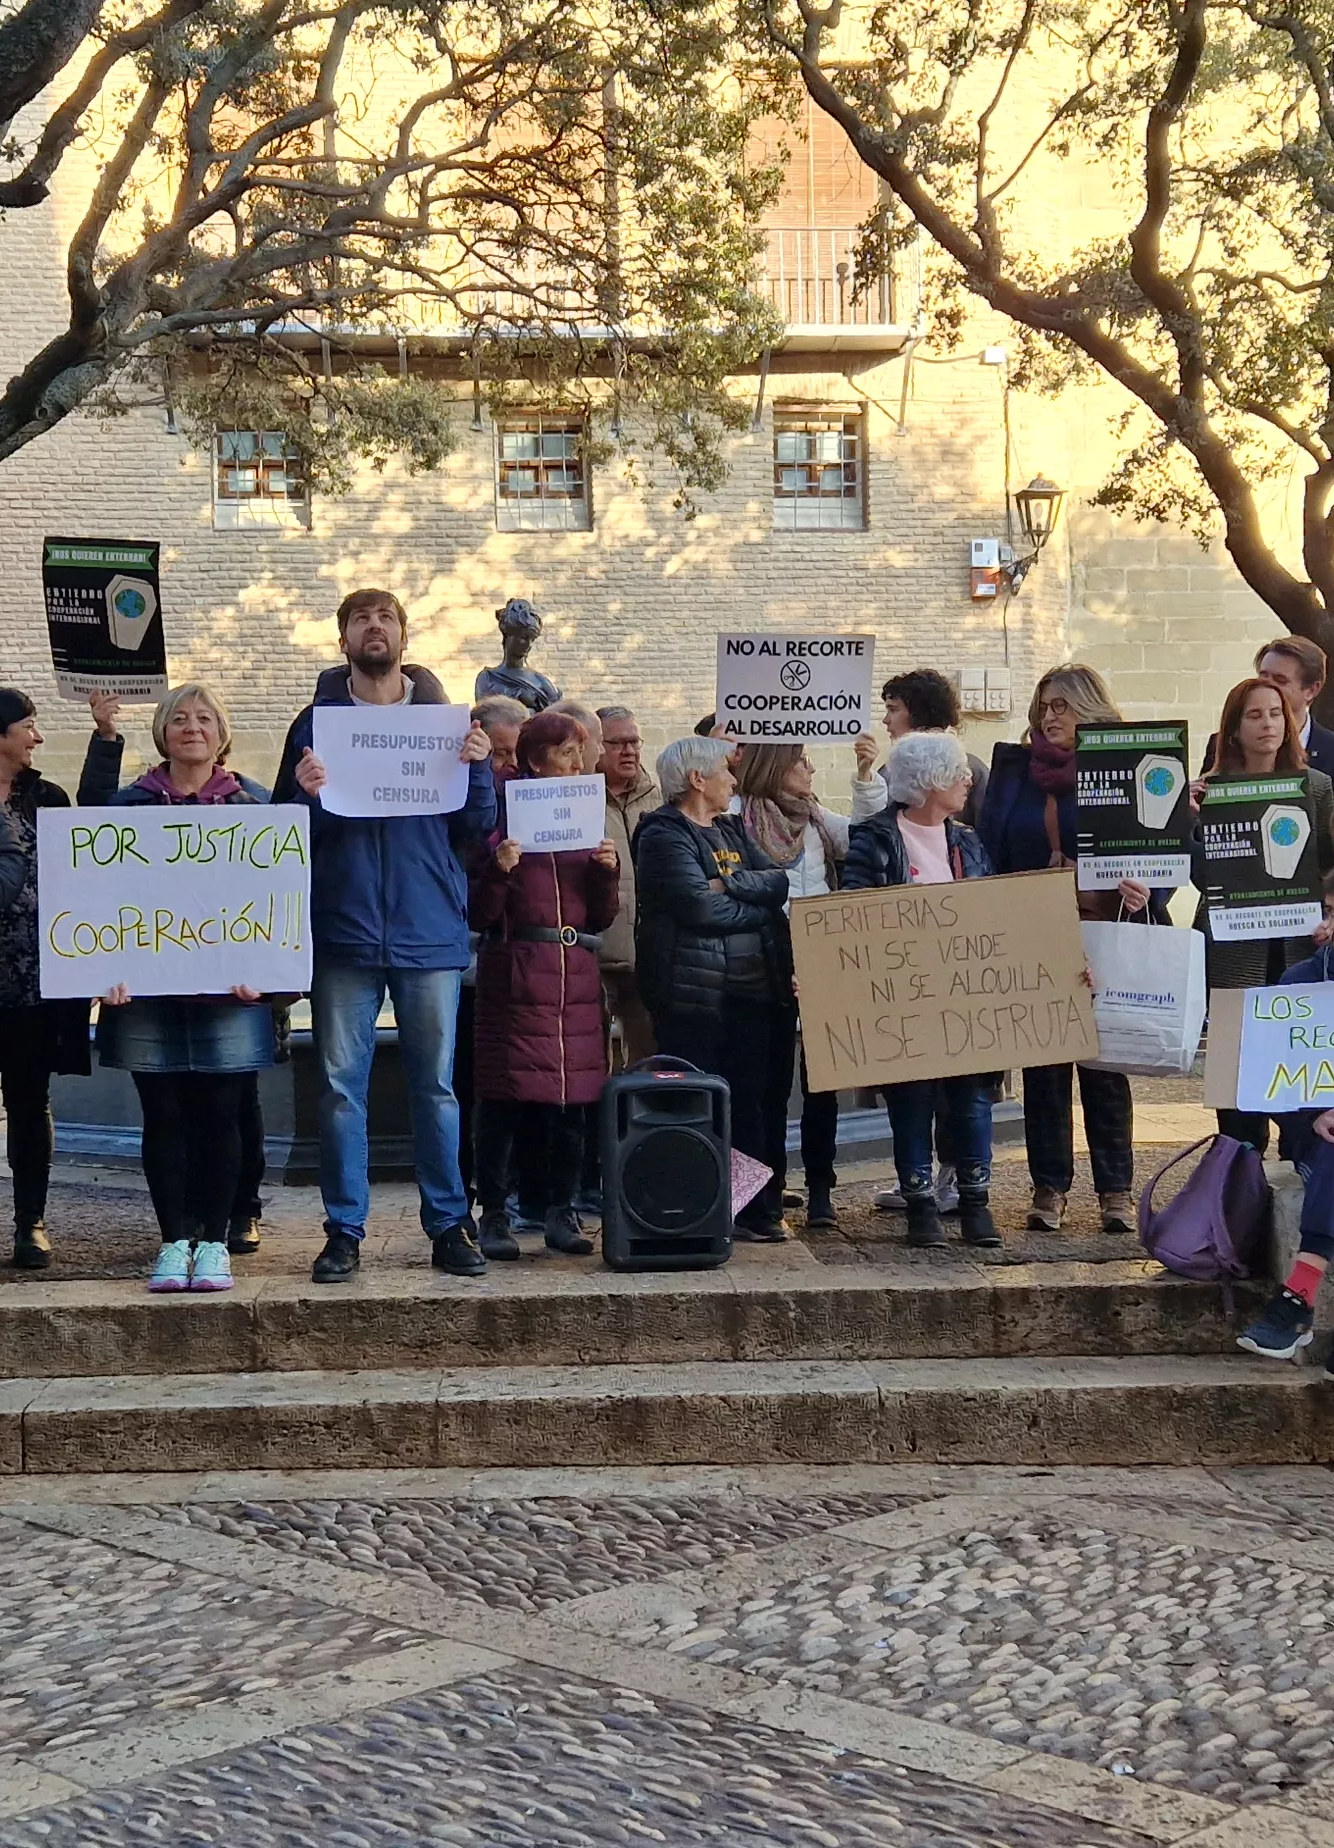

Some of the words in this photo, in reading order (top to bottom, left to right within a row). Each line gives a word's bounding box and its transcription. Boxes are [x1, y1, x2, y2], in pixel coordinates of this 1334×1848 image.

[726, 639, 755, 656] NO
[758, 640, 781, 656] AL
[785, 640, 865, 656] RECORTE
[724, 689, 861, 711] COOPERACIÓN
[724, 719, 746, 735] AL
[750, 719, 862, 736] DESARROLLO
[351, 733, 464, 751] PRESUPUESTOS
[1103, 733, 1134, 744] QUIEREN
[401, 761, 426, 777] SIN
[1077, 770, 1134, 782] ENTIERRO
[514, 783, 598, 801] PRESUPUESTOS
[1077, 781, 1094, 789] POR
[1227, 785, 1257, 796] QUIEREN
[372, 786, 440, 804] CENSURA
[1077, 787, 1124, 798] COOPERACIÓN
[1077, 797, 1131, 806] INTERNACIONAL
[553, 807, 572, 820] SIN
[1204, 821, 1259, 834] ENTIERRO
[533, 829, 583, 843] CENSURA
[1204, 835, 1221, 843] POR
[1226, 833, 1237, 841] LA
[71, 823, 151, 868] POR
[162, 821, 305, 868] JUSTICIA
[1205, 840, 1251, 851] COOPERACIÓN
[1205, 849, 1258, 860] INTERNACIONAL
[1096, 870, 1123, 879] HUESCA
[1137, 869, 1173, 878] SOLIDARIA
[804, 895, 959, 936] PERIFERIAS
[1229, 922, 1255, 930] HUESCA
[1268, 917, 1305, 928] SOLIDARIA
[838, 947, 871, 972] NI
[884, 940, 919, 970] SE
[937, 931, 1008, 964] VENDE
[870, 977, 896, 1005] NI
[909, 973, 936, 1001] SE
[949, 961, 1056, 996] ALQUILA
[1254, 994, 1314, 1020] LOS
[824, 1015, 868, 1072] NI
[874, 1014, 927, 1062] SE
[938, 995, 1089, 1058] DISFRUTA
